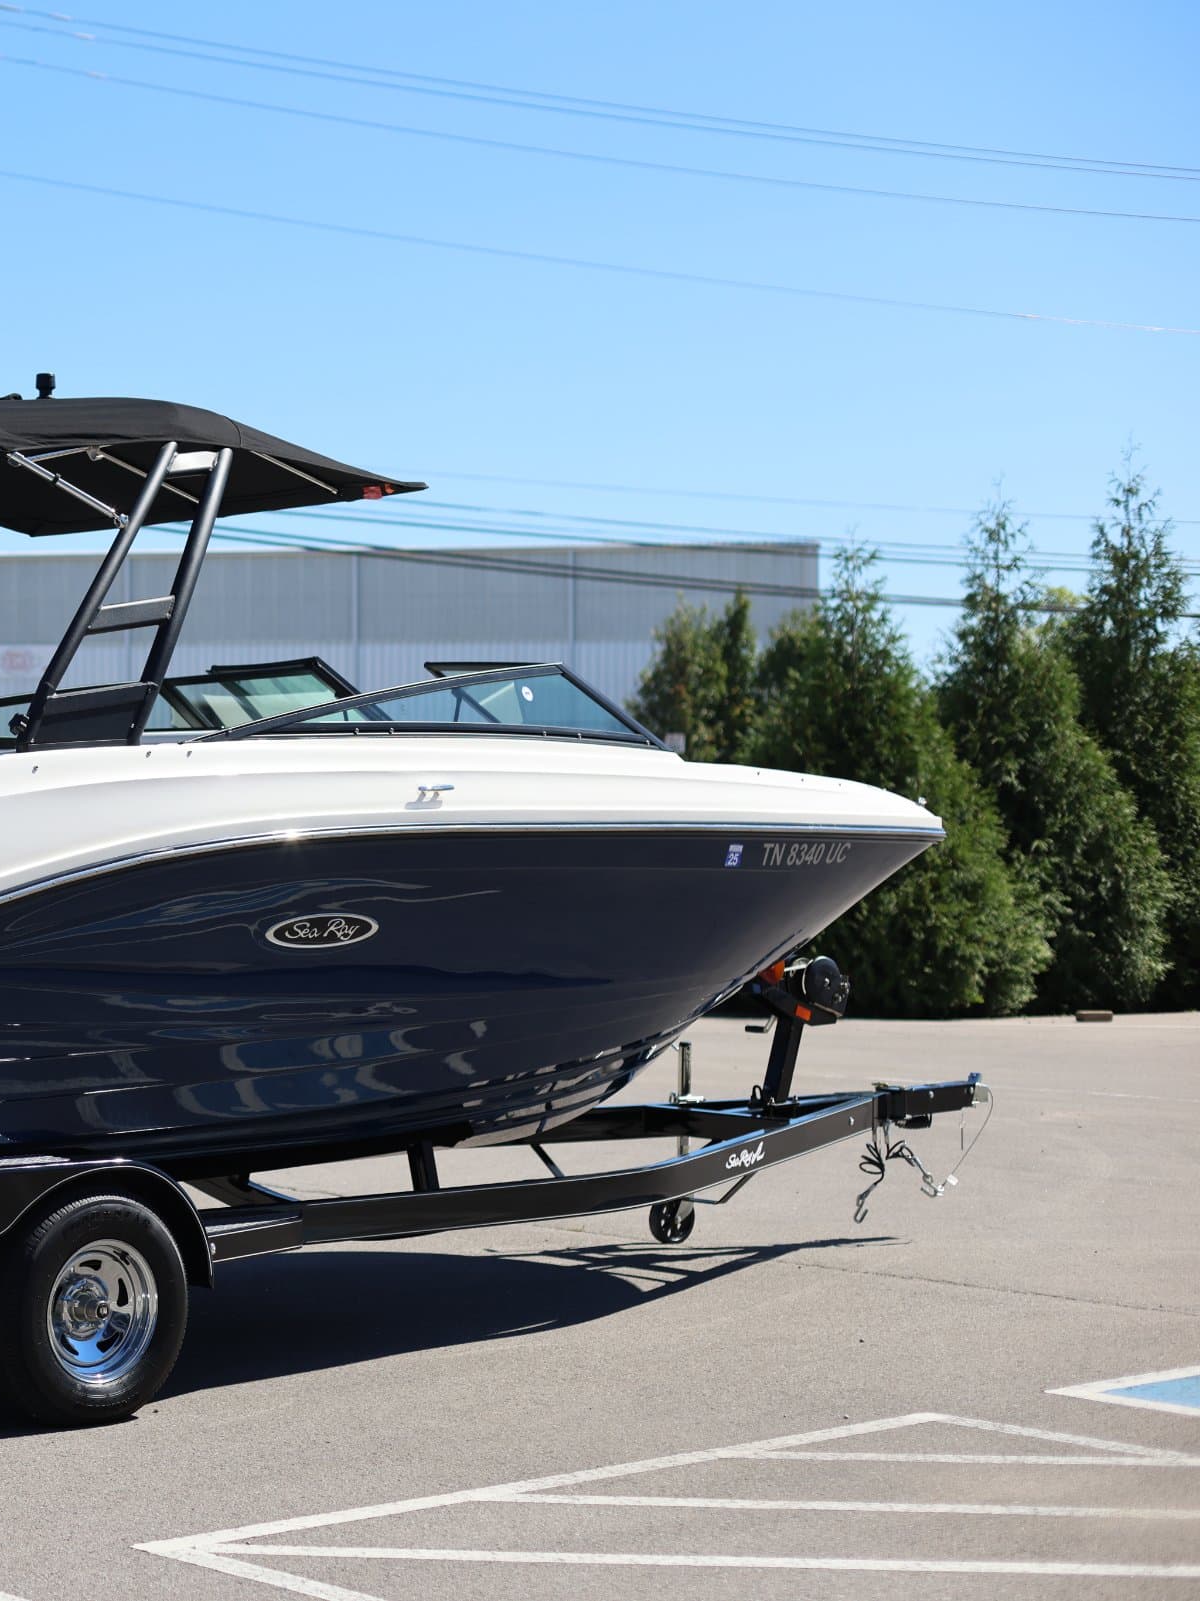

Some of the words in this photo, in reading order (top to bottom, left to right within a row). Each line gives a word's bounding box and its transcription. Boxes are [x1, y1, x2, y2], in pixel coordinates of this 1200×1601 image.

[727, 851, 741, 867] 25
[761, 843, 784, 867] TN
[786, 843, 824, 865] 8340
[825, 842, 851, 864] UC
[284, 921, 321, 940] Sea
[322, 918, 361, 941] Ray
